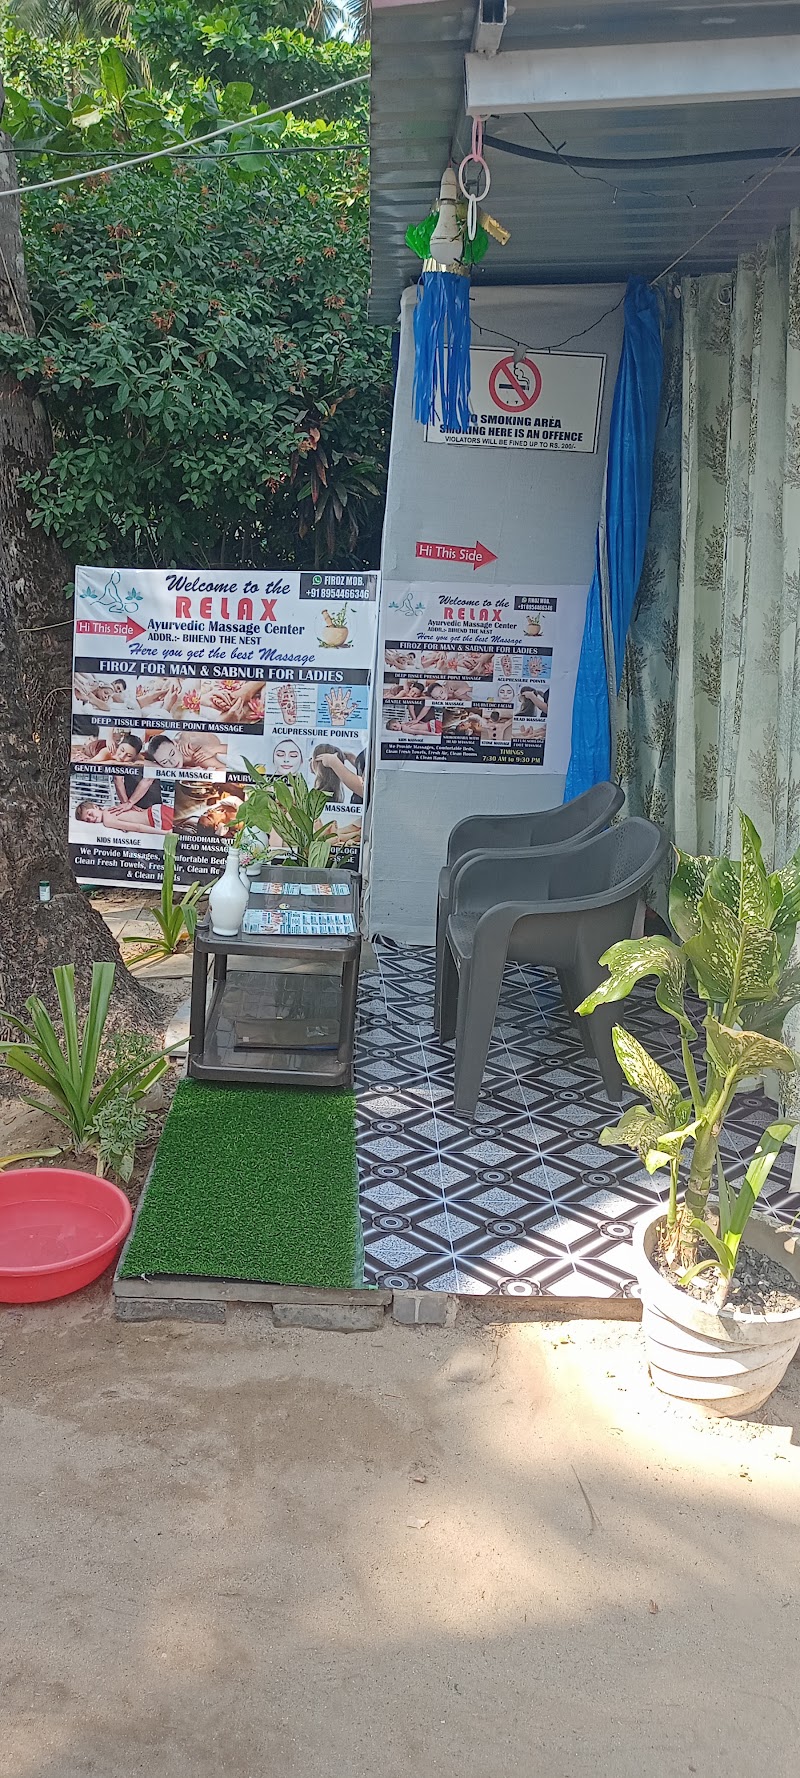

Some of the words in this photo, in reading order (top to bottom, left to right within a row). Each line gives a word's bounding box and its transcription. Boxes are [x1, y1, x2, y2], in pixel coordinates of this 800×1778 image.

[480, 414, 531, 427] SMOKING
[534, 417, 562, 429] AREA
[445, 436, 481, 444] VIOLATORS
[488, 428, 513, 438] HERE
[514, 429, 525, 438] IS
[527, 429, 540, 439] AN
[542, 430, 584, 442] OFFENCE
[419, 544, 433, 557] Hi
[435, 546, 456, 559] This
[459, 548, 483, 562] Side
[165, 574, 237, 592] Welcome
[242, 580, 260, 594] to
[265, 578, 291, 595] the
[324, 575, 345, 586] FIROZ
[175, 595, 278, 621] RELAX
[438, 595, 480, 607] Welcome
[495, 598, 510, 608] the
[443, 607, 503, 622] RELAX
[78, 623, 91, 632] Hi
[92, 624, 111, 633] This
[113, 625, 134, 635] Side
[147, 619, 205, 631] Ayurvedic
[208, 621, 260, 635] Massage
[264, 623, 305, 635] Center
[427, 619, 461, 627] Ayurvedic
[463, 621, 492, 629] Massage
[494, 622, 517, 630] Center
[182, 634, 216, 643] BIHEND
[219, 635, 236, 644] THE
[239, 636, 262, 645] NEST
[417, 632, 435, 640] Here
[450, 635, 460, 643] get
[491, 635, 523, 645] Massage
[128, 643, 158, 656] Here
[162, 648, 184, 660] you
[186, 647, 206, 661] get
[207, 647, 227, 659] the
[230, 647, 254, 660] best
[258, 648, 315, 666] Massage
[440, 643, 456, 651] MAN
[465, 645, 494, 653] SABNUR
[512, 647, 538, 655] LADIES
[99, 660, 137, 673] FIROZ
[140, 662, 166, 674] FOR
[169, 664, 196, 675] MAN
[200, 665, 210, 676] &
[212, 666, 264, 679] SABNUR
[268, 668, 294, 680] FOR
[298, 669, 344, 682] LADIES
[91, 716, 112, 725] DEEP
[114, 717, 139, 727] TISSUE
[141, 720, 180, 729] PRESSURE
[182, 722, 206, 731] POINT
[208, 723, 244, 733] MASSAGE
[272, 727, 328, 737] ACUPRESSURE
[330, 729, 359, 738] POINTS
[74, 764, 103, 773] GENTLE
[104, 766, 139, 776] MASSAGE
[155, 769, 177, 778] BACK
[178, 771, 213, 780] MASSAGE
[324, 804, 361, 813] MASSAGE
[96, 836, 111, 844] KIDS
[112, 837, 141, 846] MASSAGE
[80, 847, 92, 855] We
[95, 848, 121, 857] Provide
[122, 850, 161, 861] Massages,
[180, 843, 200, 851] HEAD
[201, 845, 229, 853] MASSAG
[74, 857, 95, 865] Clean
[97, 859, 118, 867] Fresh
[119, 860, 147, 870] Towels,
[148, 862, 165, 870] Fres
[187, 865, 208, 874] Clean
[134, 871, 155, 880] Clean
